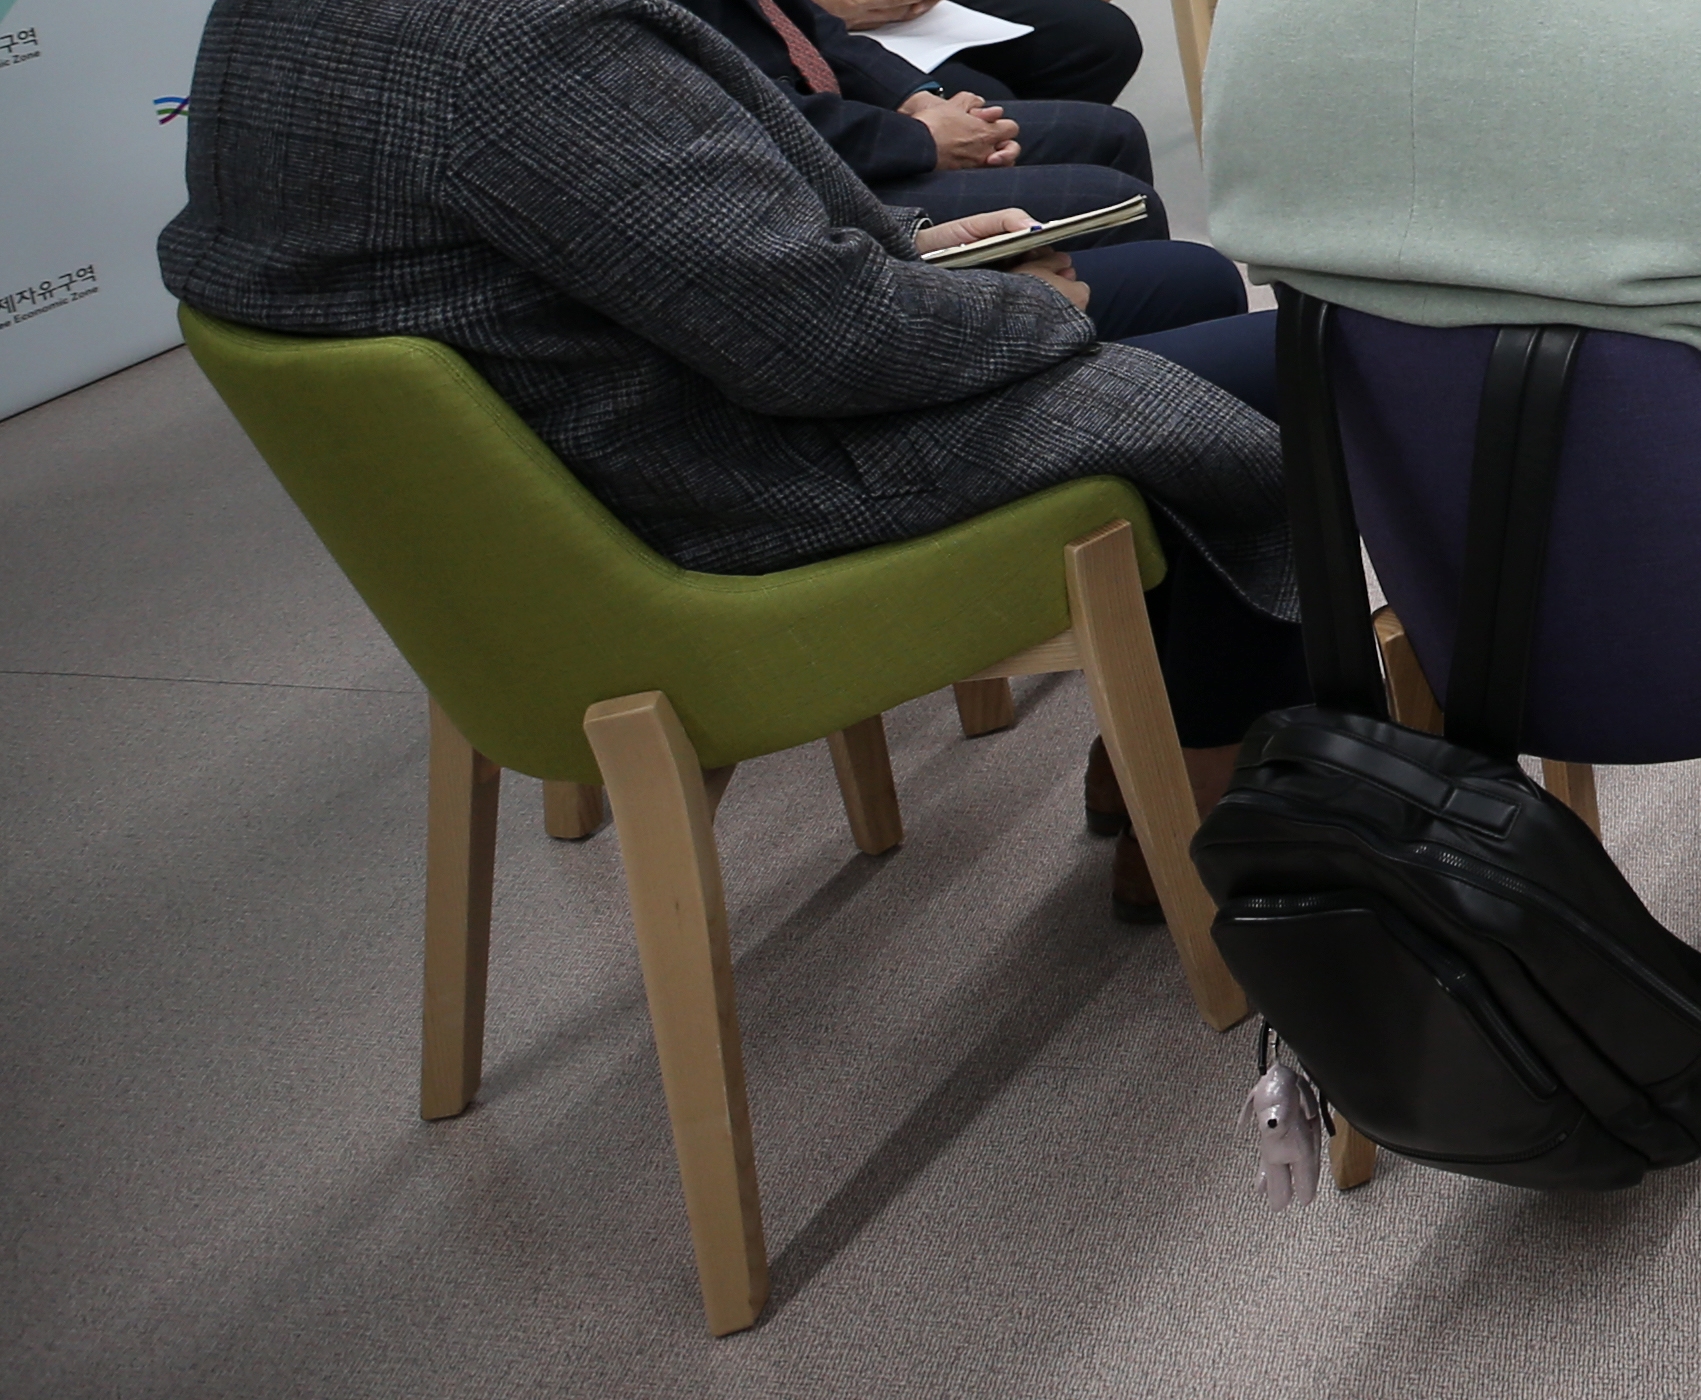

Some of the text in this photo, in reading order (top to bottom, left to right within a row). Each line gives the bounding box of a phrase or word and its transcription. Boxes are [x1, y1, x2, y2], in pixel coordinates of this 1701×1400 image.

[12, 50, 41, 64] Zone
[13, 298, 69, 325] Economic
[70, 285, 99, 303] Zone
